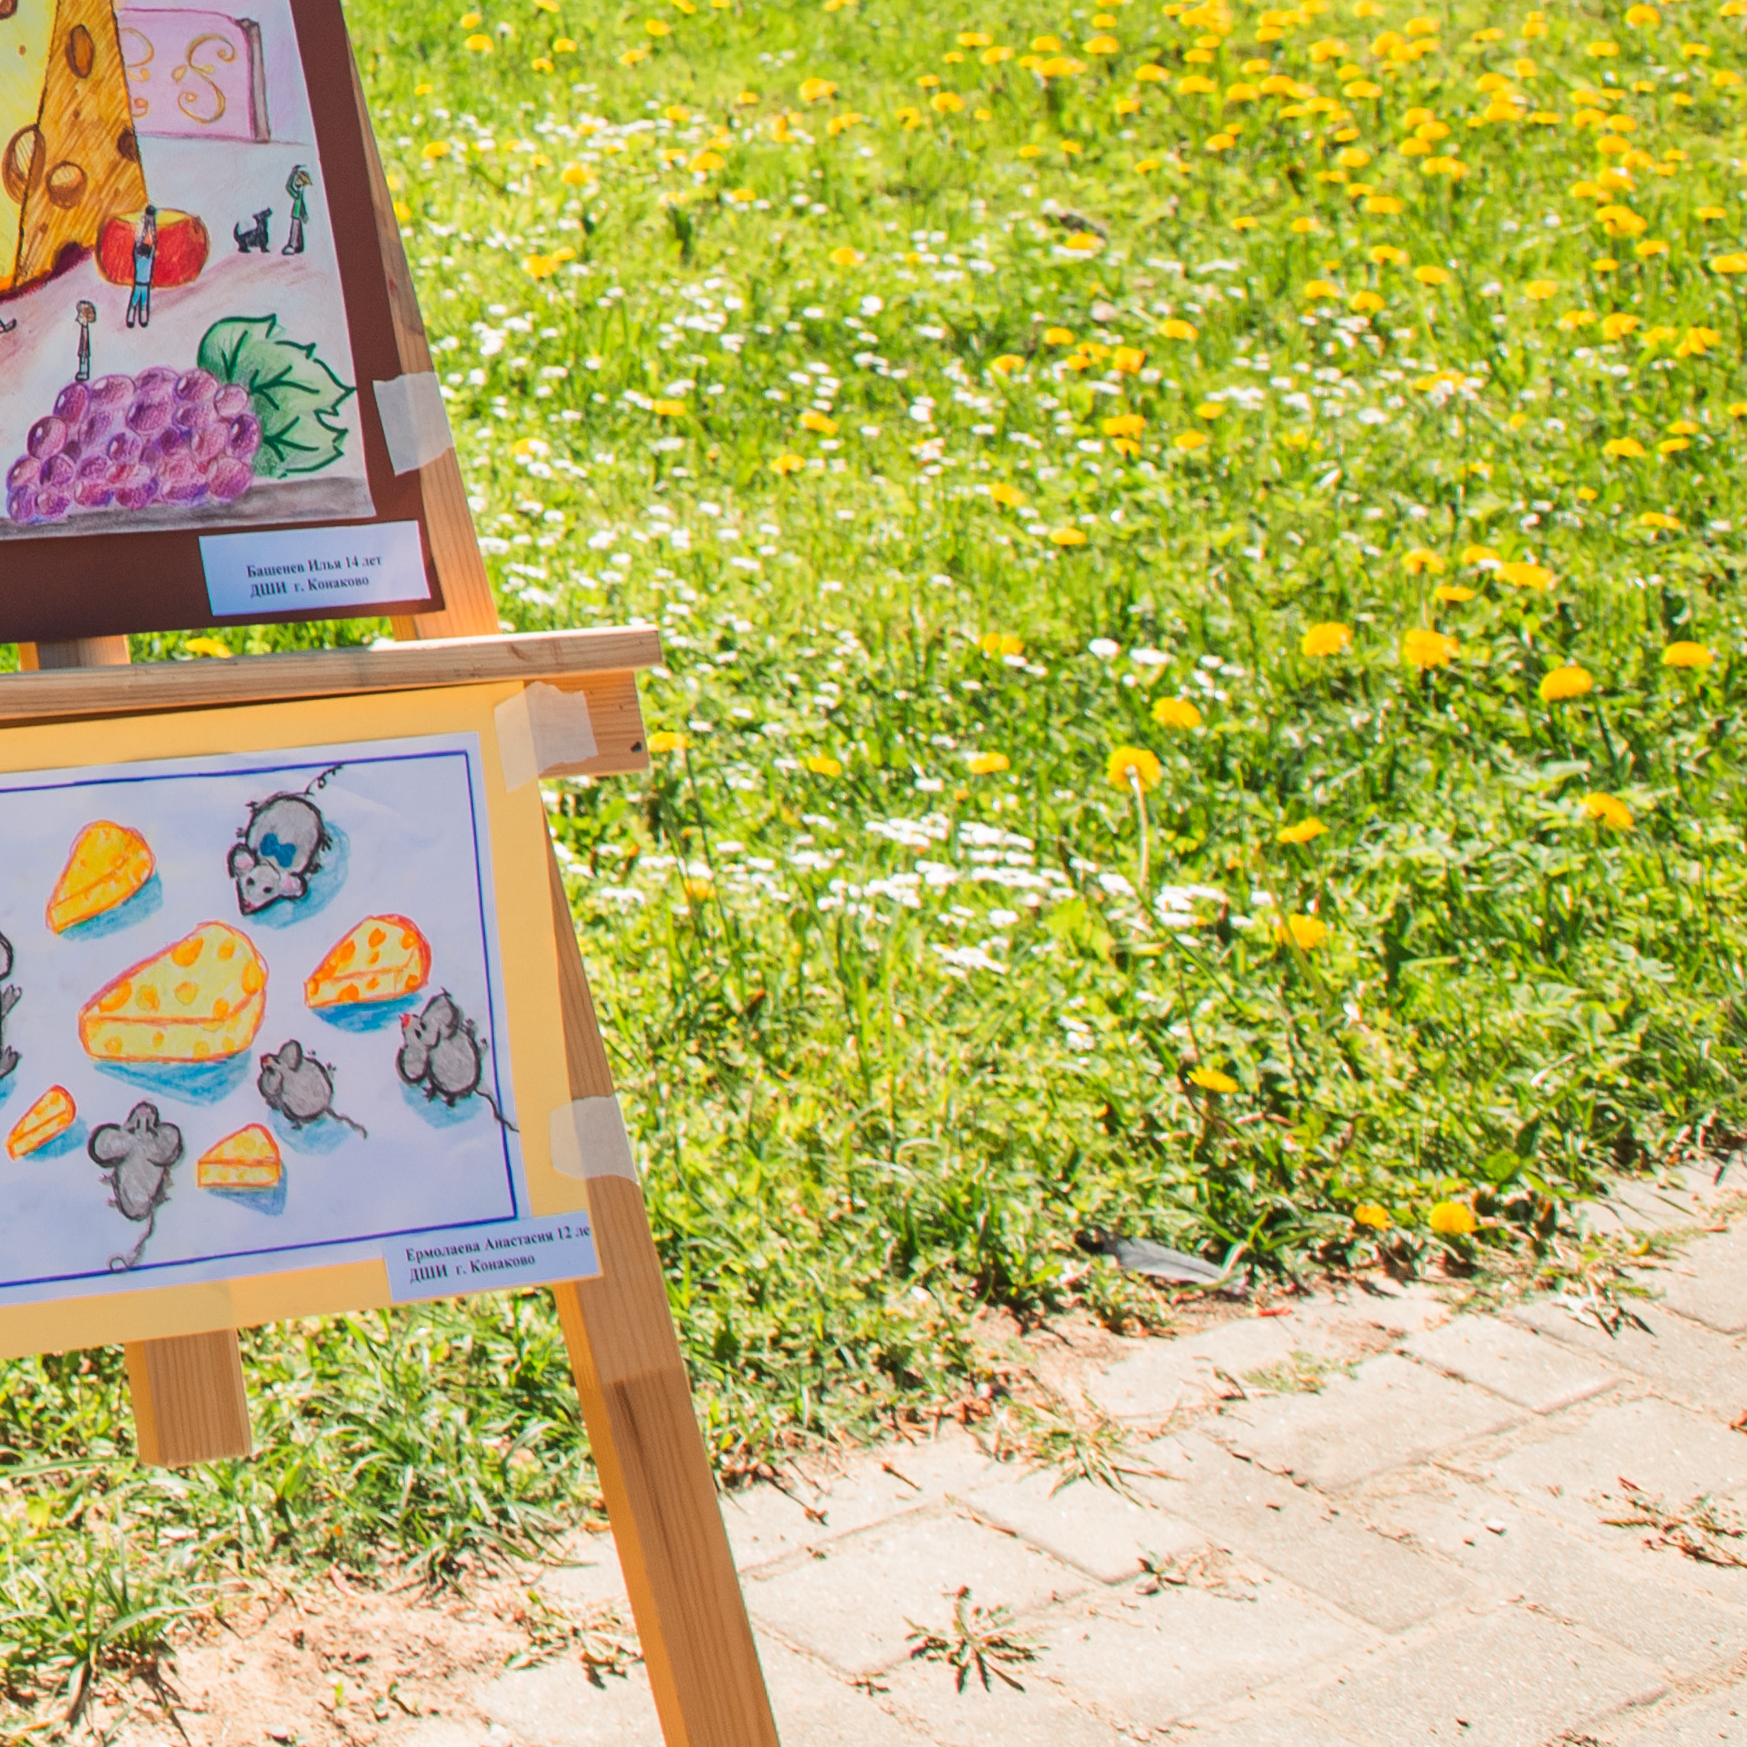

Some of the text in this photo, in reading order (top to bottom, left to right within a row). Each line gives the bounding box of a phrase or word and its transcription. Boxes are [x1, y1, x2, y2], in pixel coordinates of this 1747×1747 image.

[246, 556, 382, 578] Башенев Илья 14 лет
[250, 576, 370, 598] ДШИ г. Конаково
[405, 1226, 591, 1264] Ермолаева Анастасия 12 ле
[409, 1254, 535, 1284] ДШИ г. Конаково
